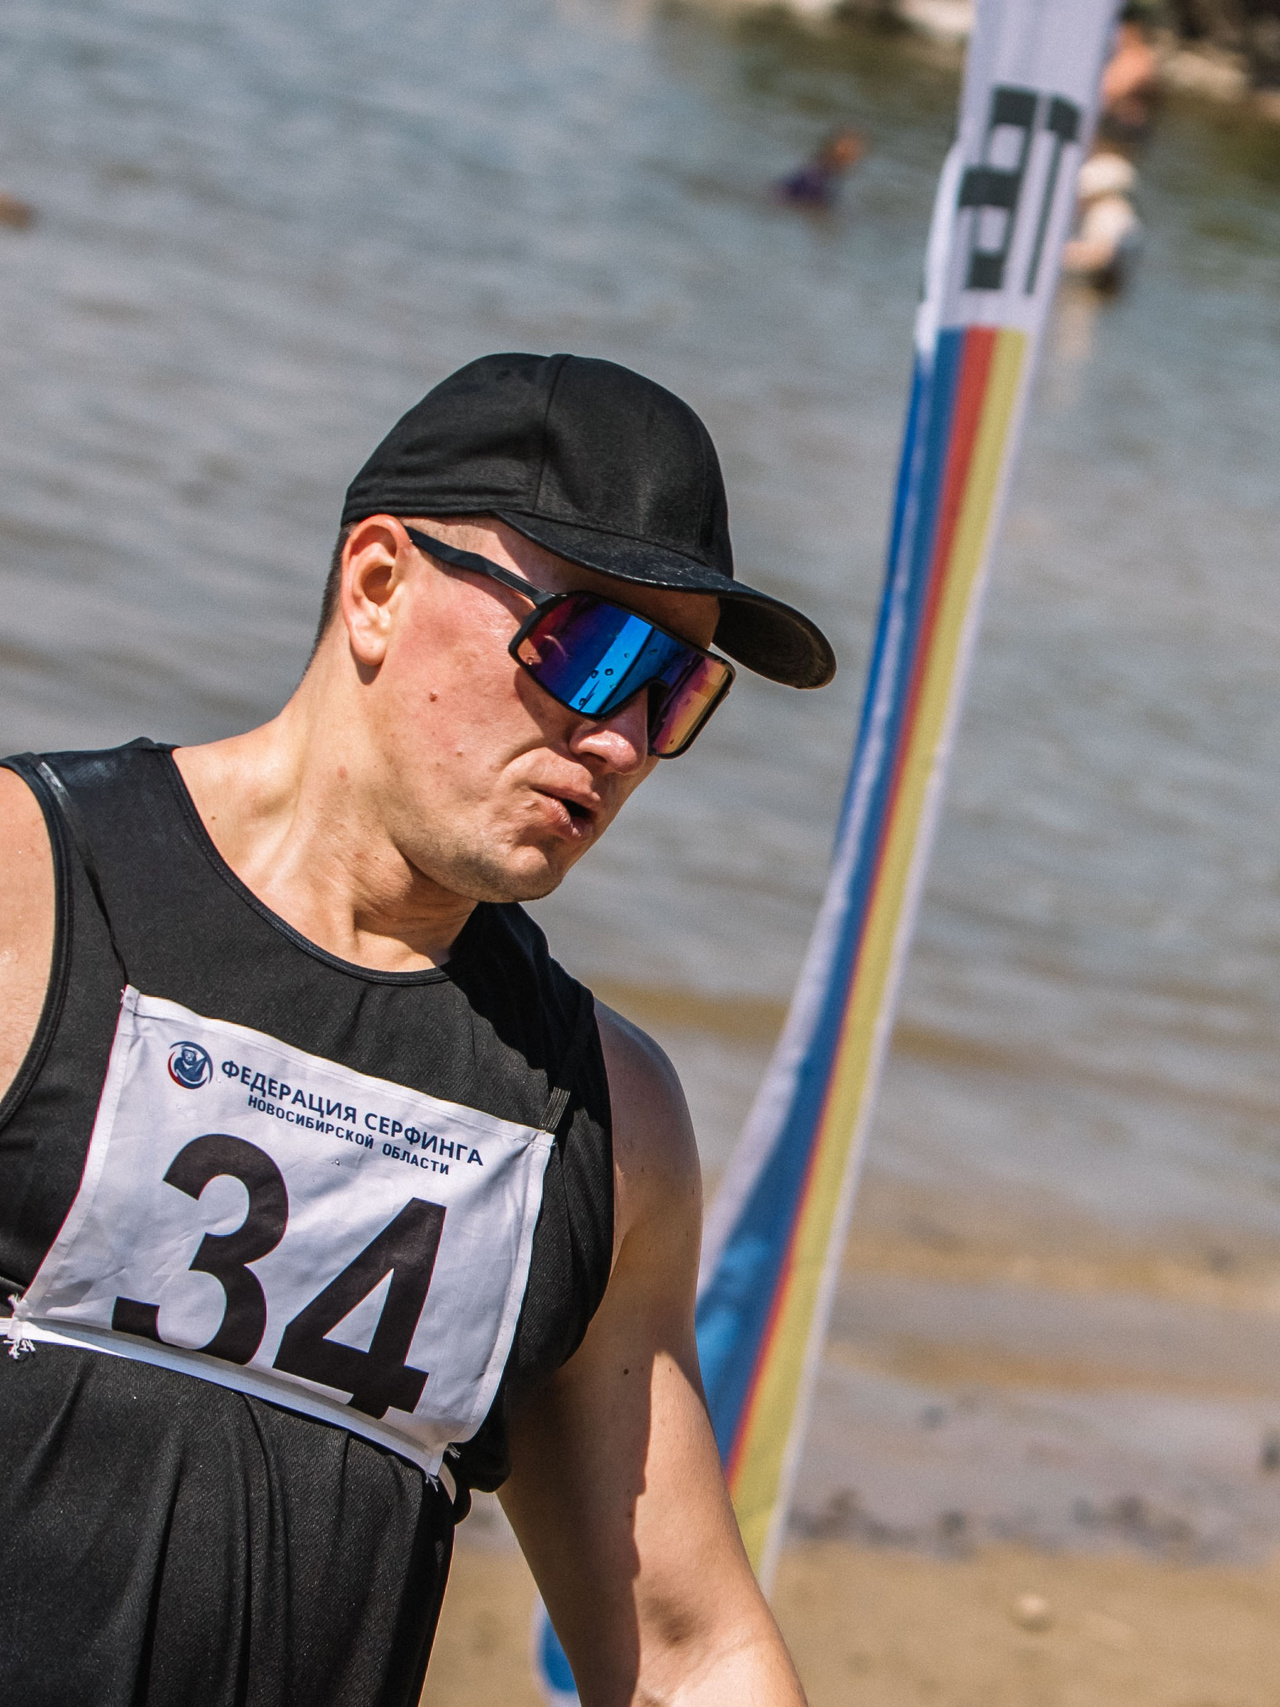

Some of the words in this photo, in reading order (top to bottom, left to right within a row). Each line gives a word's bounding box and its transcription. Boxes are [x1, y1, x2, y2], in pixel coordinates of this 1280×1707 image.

[221, 1060, 357, 1125] ФЕДЕРАЦИЯ
[364, 1112, 484, 1167] СЕРФИНГА
[247, 1094, 375, 1150] НОВОСИБИРСКОЙ
[382, 1142, 450, 1176] ОБЛАСТИ
[111, 1132, 447, 1420] 34
